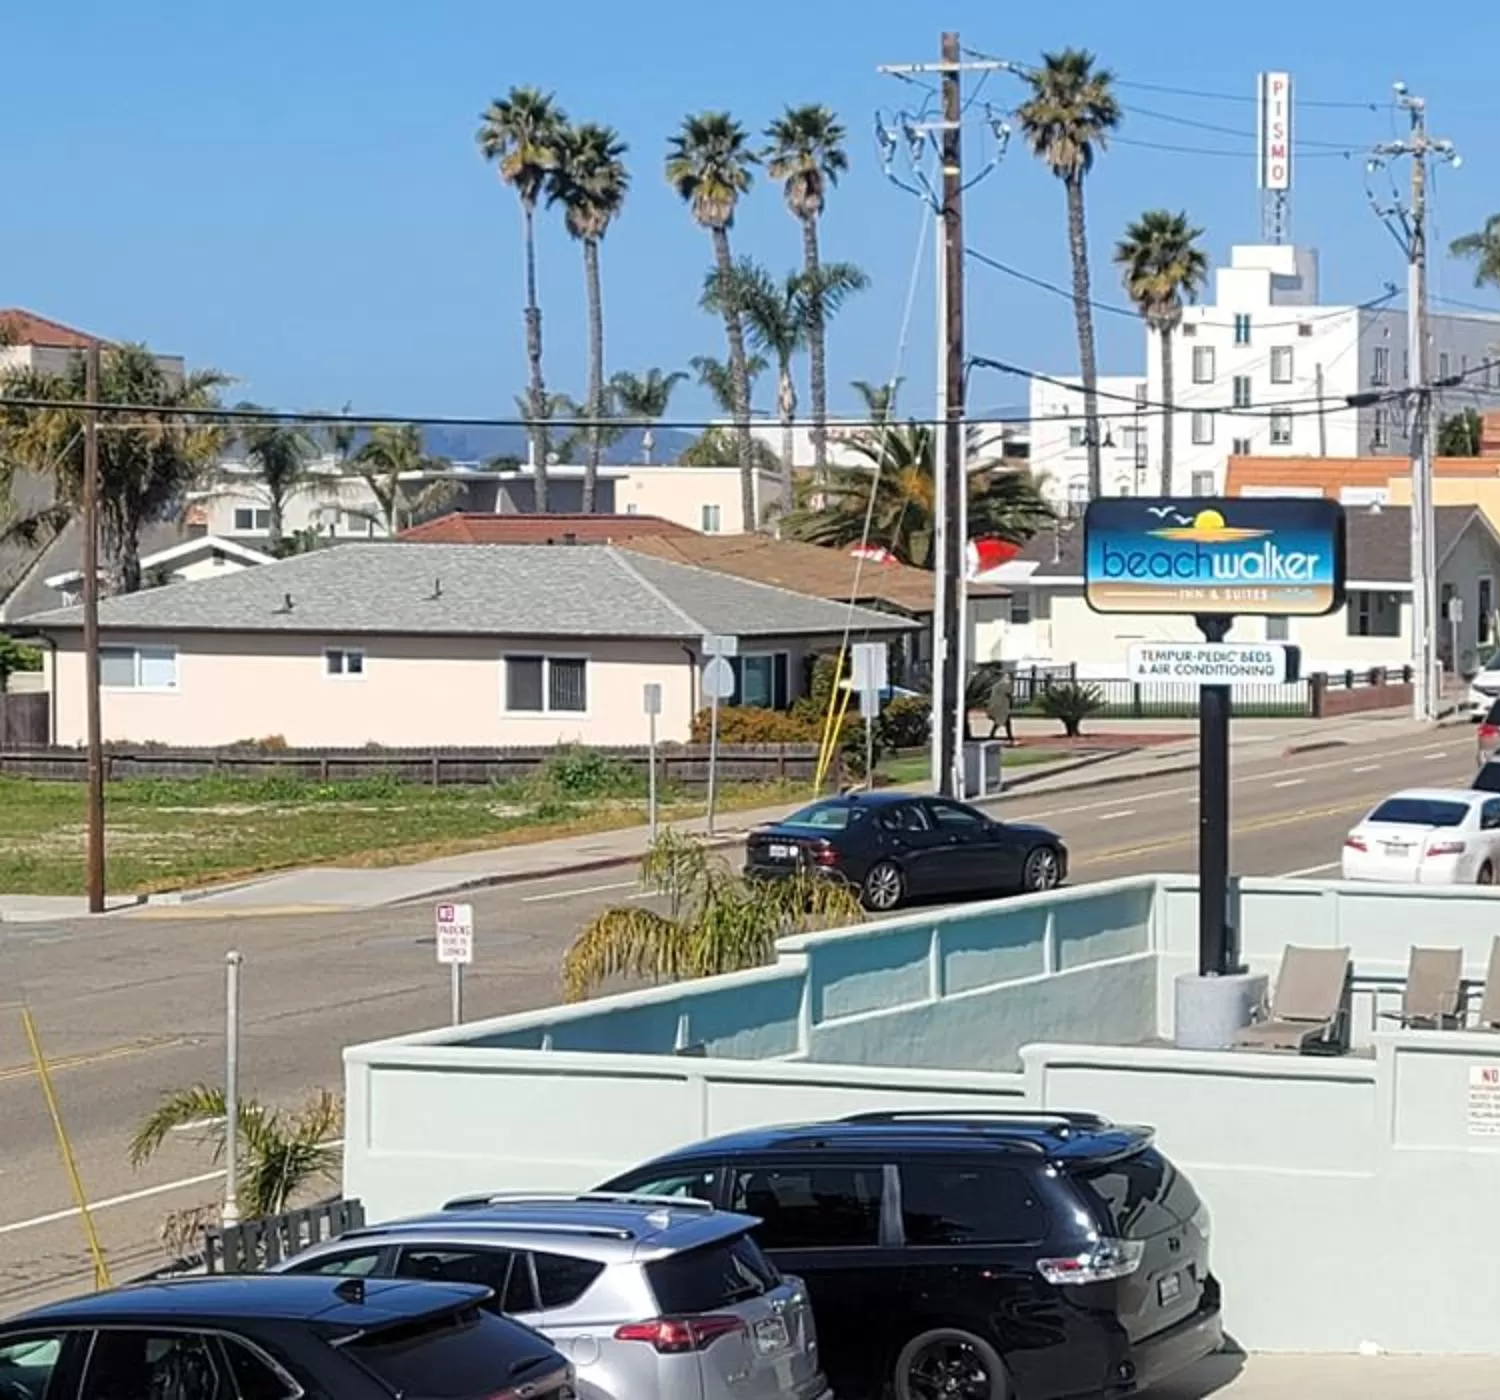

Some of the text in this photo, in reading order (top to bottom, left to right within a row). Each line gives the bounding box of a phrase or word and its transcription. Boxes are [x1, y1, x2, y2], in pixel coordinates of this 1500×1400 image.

[1271, 79, 1285, 181] PISMO
[1102, 540, 1319, 579] beachwalker
[1179, 588, 1205, 600] INN
[1224, 588, 1268, 601] SUITES
[1240, 651, 1273, 663] BEDS
[1150, 664, 1171, 675] AIR
[1174, 664, 1276, 677] CONDITIONING
[1481, 1068, 1499, 1084] NO
